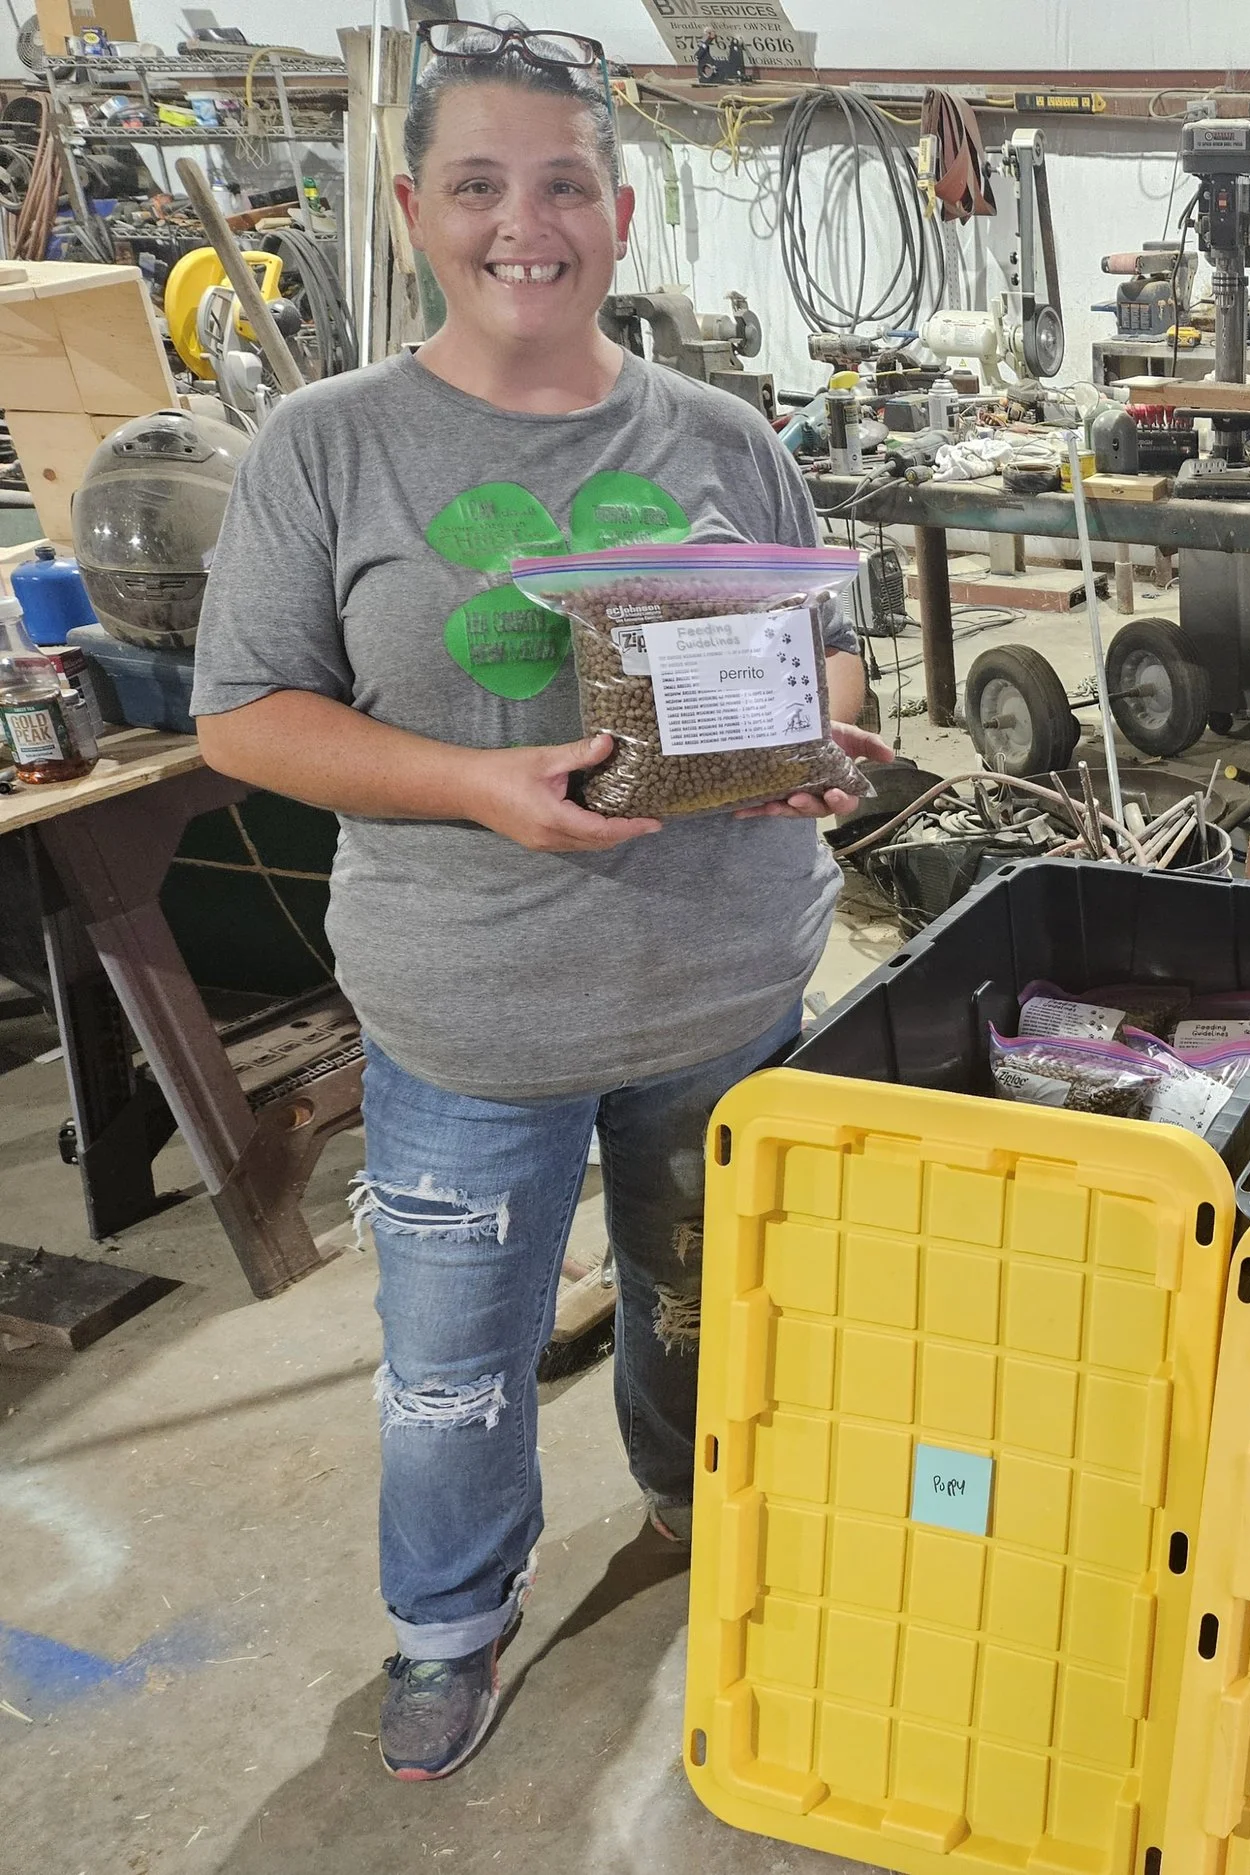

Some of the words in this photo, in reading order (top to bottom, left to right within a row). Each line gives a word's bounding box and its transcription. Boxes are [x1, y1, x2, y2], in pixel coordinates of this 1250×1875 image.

[701, 5, 777, 17] SERVICES
[743, 22, 782, 31] OWNER
[676, 623, 733, 638] Feeding
[676, 635, 740, 651] Guidelines
[719, 666, 765, 683] perrito
[11, 713, 48, 729] GOLD
[15, 727, 53, 742] PEAK
[1191, 1029, 1229, 1038] Guidelines
[1195, 1024, 1227, 1032] Feeding
[1000, 1071, 1028, 1088] Ziploc
